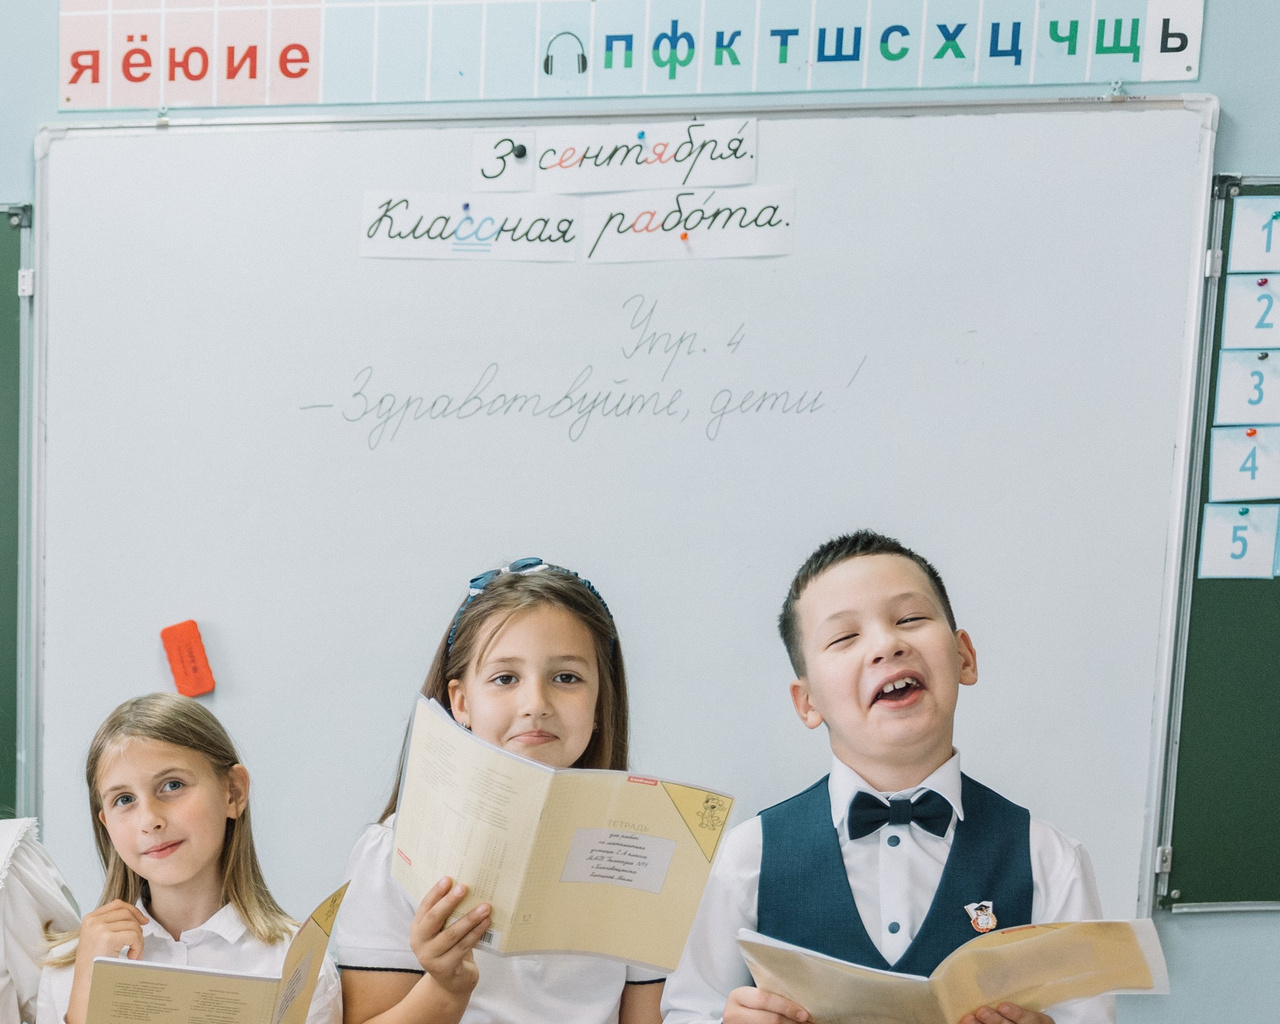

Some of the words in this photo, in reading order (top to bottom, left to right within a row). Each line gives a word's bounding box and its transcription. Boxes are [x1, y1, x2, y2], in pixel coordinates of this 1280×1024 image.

[481, 138, 516, 179] 3
[367, 198, 576, 244] Классная
[1261, 217, 1275, 253] 1
[1255, 293, 1274, 330] 2
[621, 293, 708, 382] Упр.
[726, 322, 746, 354] 4
[1247, 371, 1265, 406] 3
[1239, 445, 1259, 481] 4
[1230, 525, 1249, 561] 5
